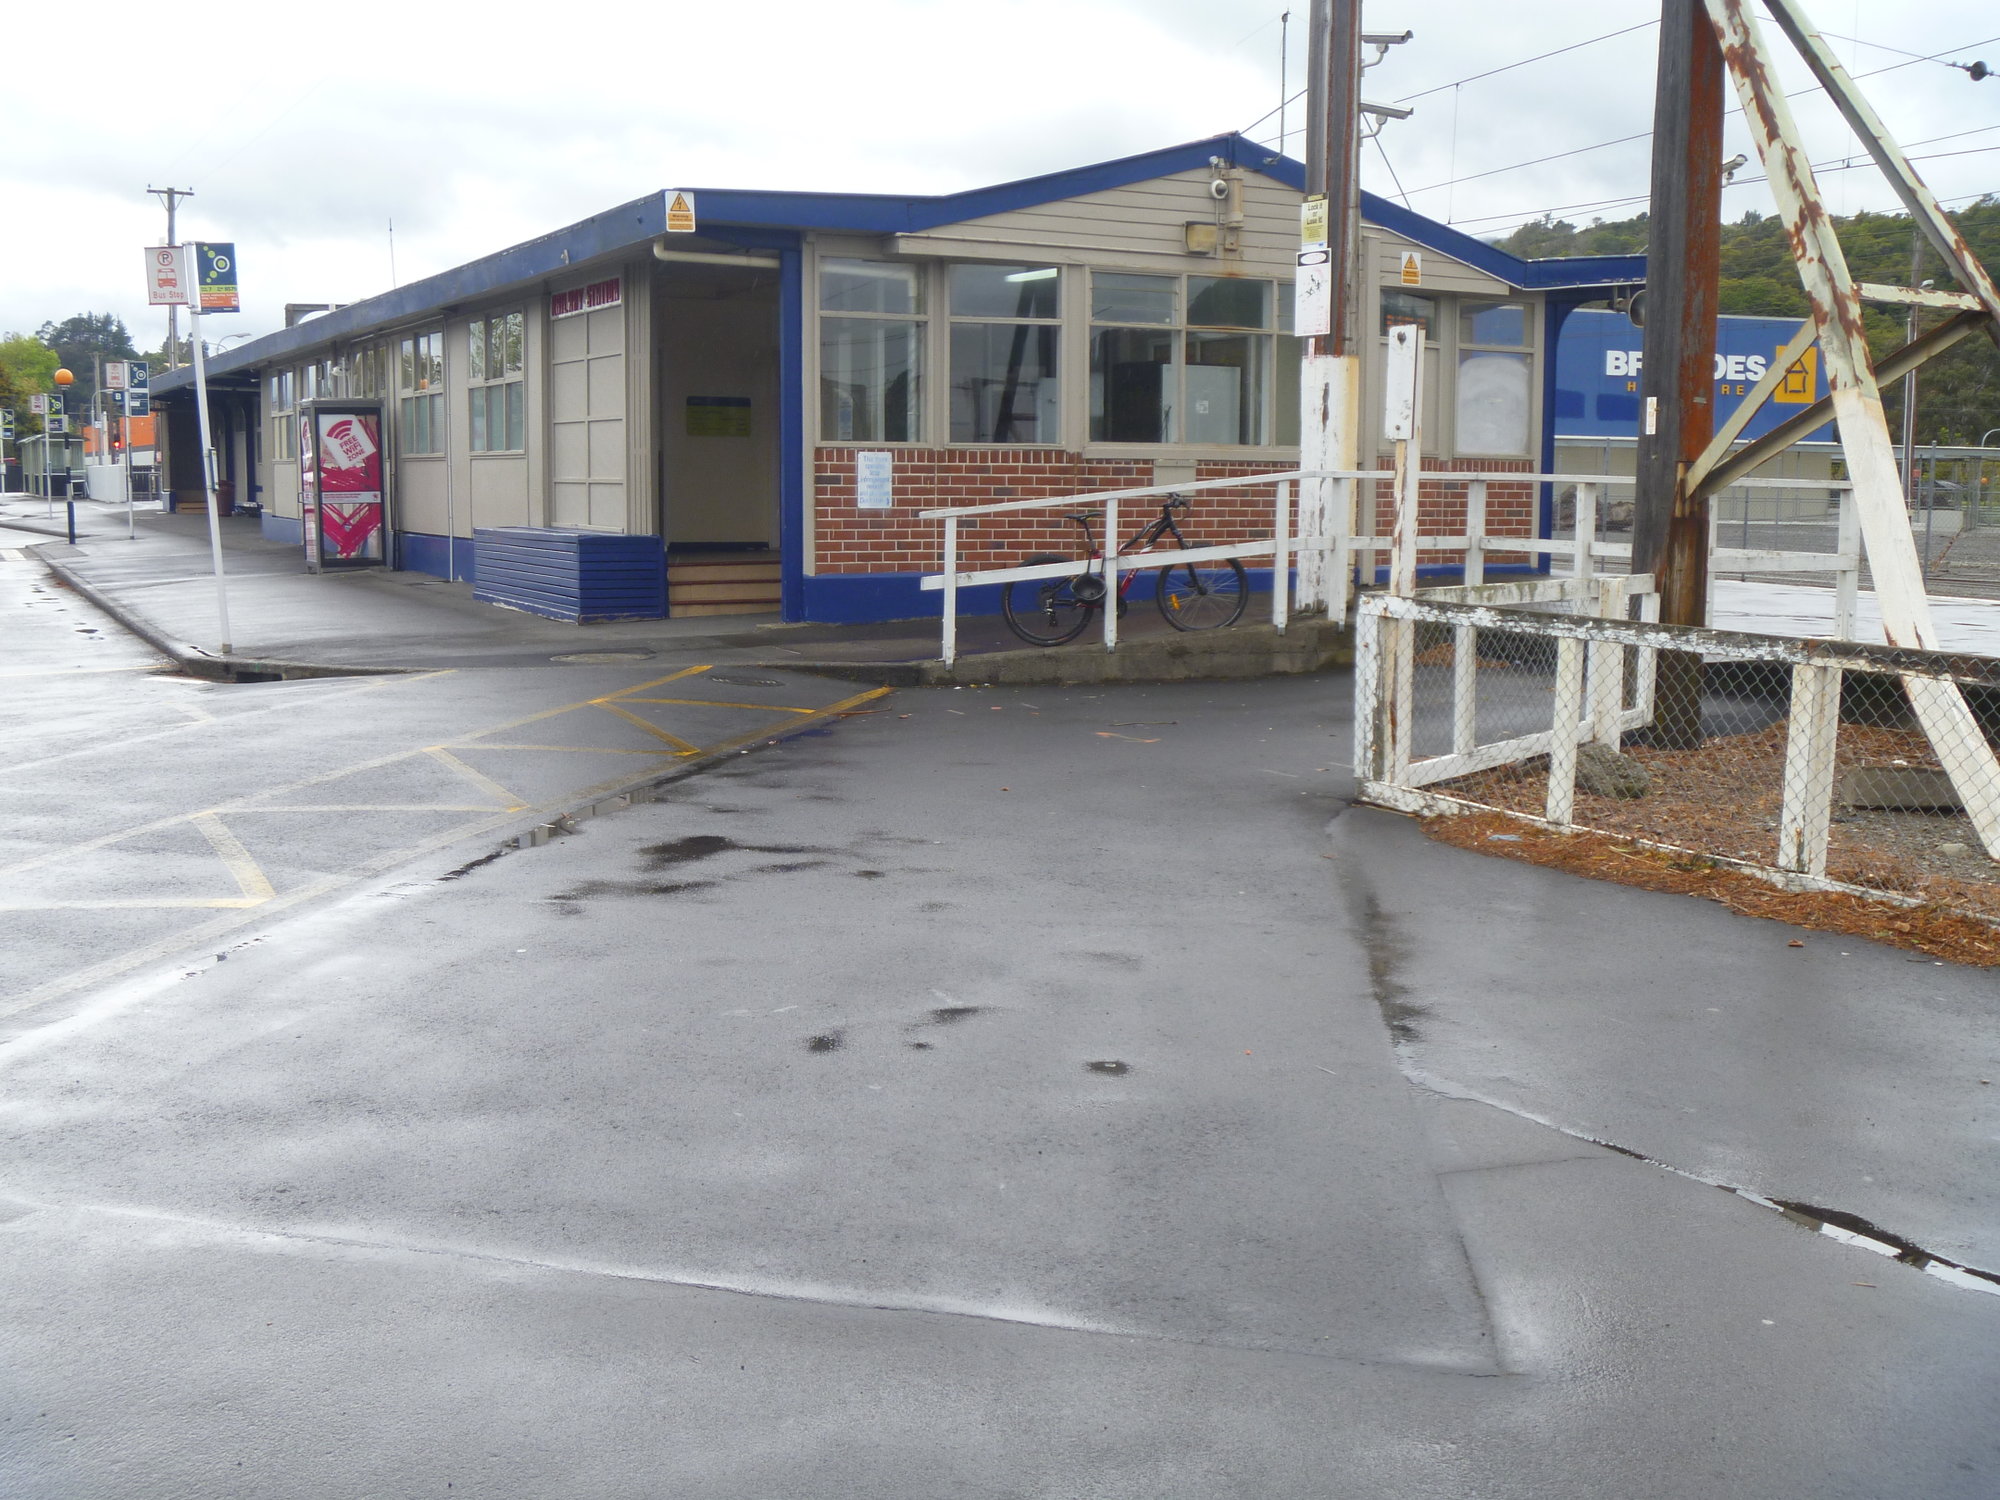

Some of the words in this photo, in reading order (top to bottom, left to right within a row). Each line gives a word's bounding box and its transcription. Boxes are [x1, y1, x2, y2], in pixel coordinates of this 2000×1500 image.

[153, 291, 166, 299] Bus
[169, 291, 185, 300] Stop
[585, 277, 620, 307] STATION
[114, 392, 122, 400] B
[339, 434, 358, 449] FREE
[347, 447, 366, 462] ZONE
